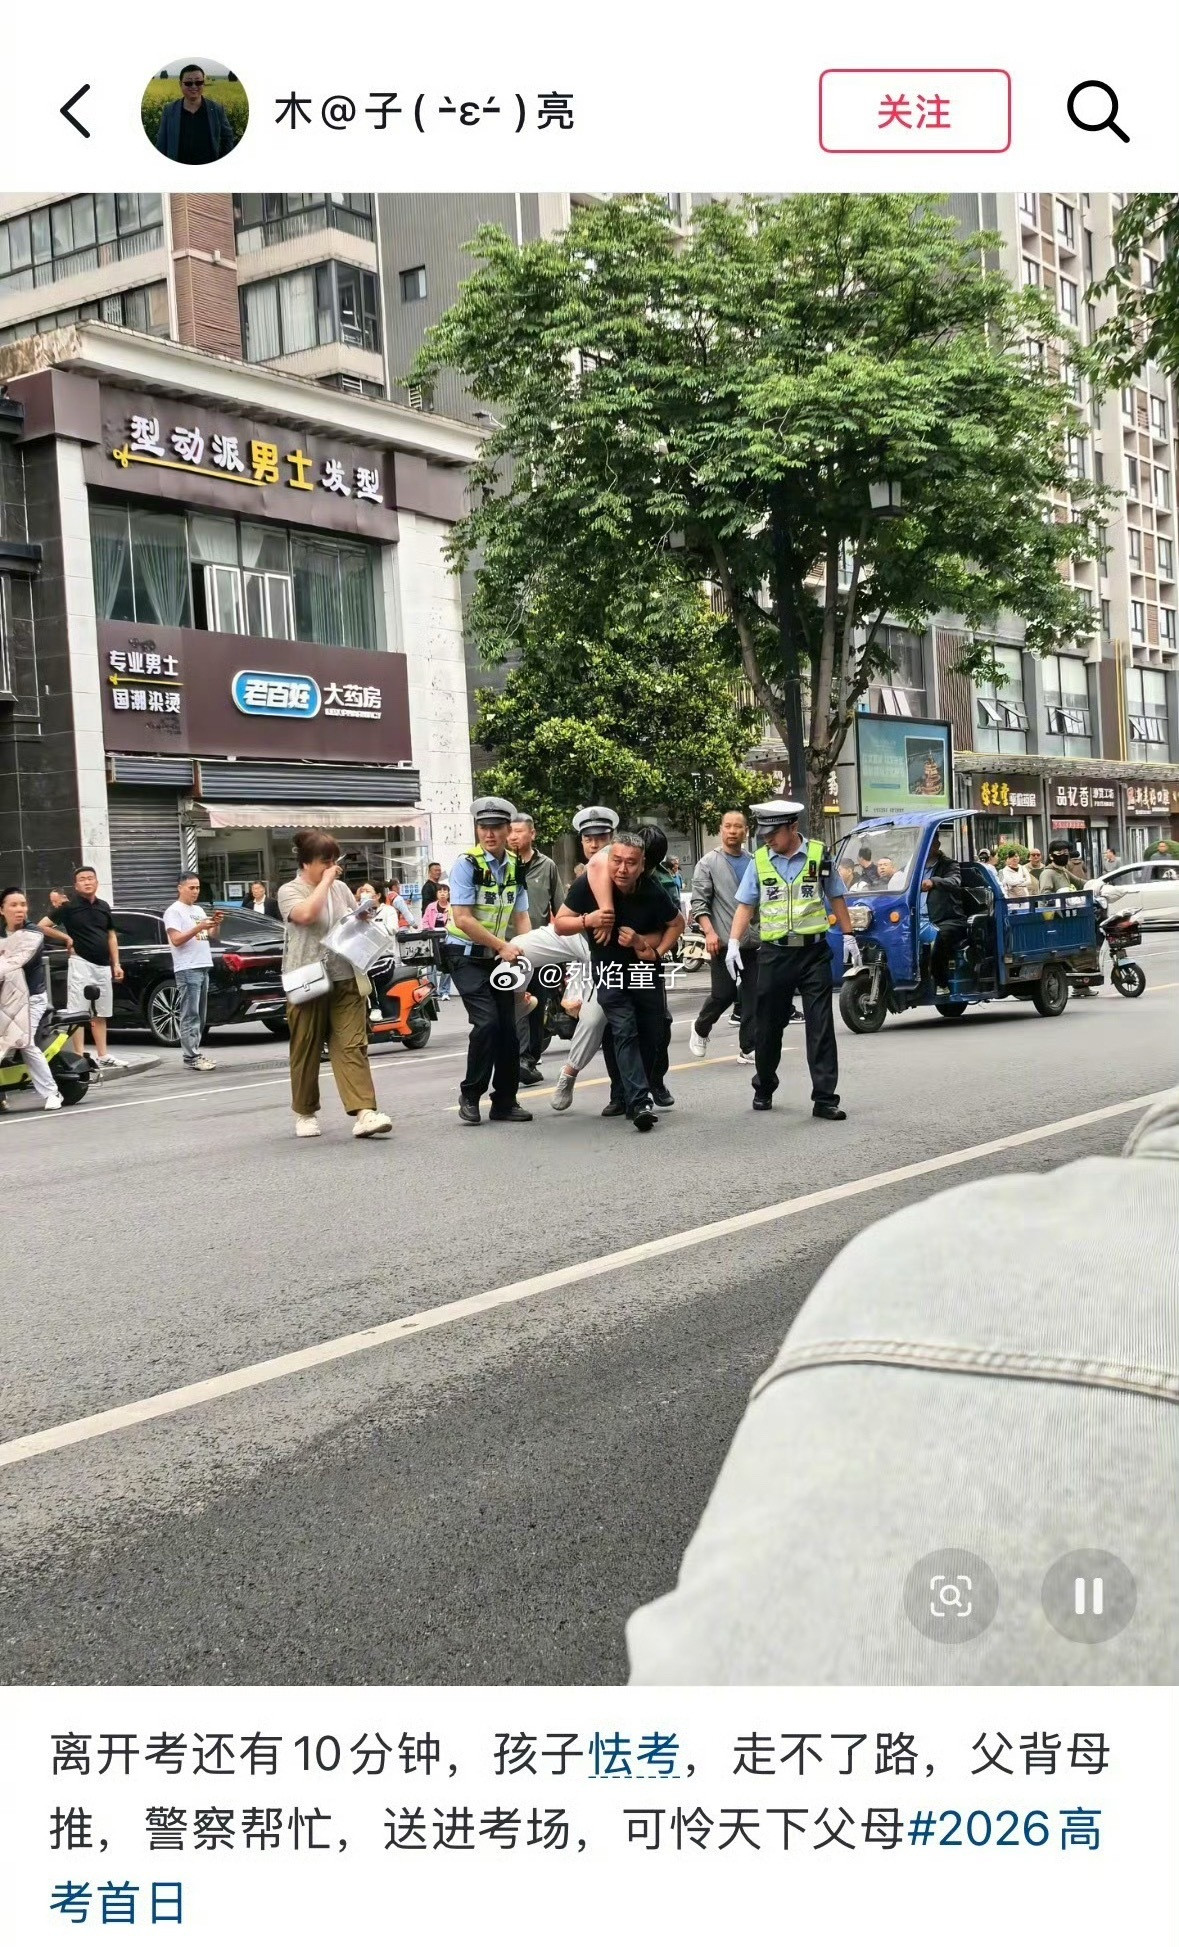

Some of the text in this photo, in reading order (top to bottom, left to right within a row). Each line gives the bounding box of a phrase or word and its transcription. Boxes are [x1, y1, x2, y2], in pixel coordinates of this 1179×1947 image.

[129, 415, 384, 504] 型动派男士发型
[109, 650, 179, 676] 专业男士
[112, 688, 181, 713] 国潮染烫
[243, 679, 382, 709] 老百姓 大药房
[484, 891, 515, 905] 警察
[766, 885, 815, 901] 警察
